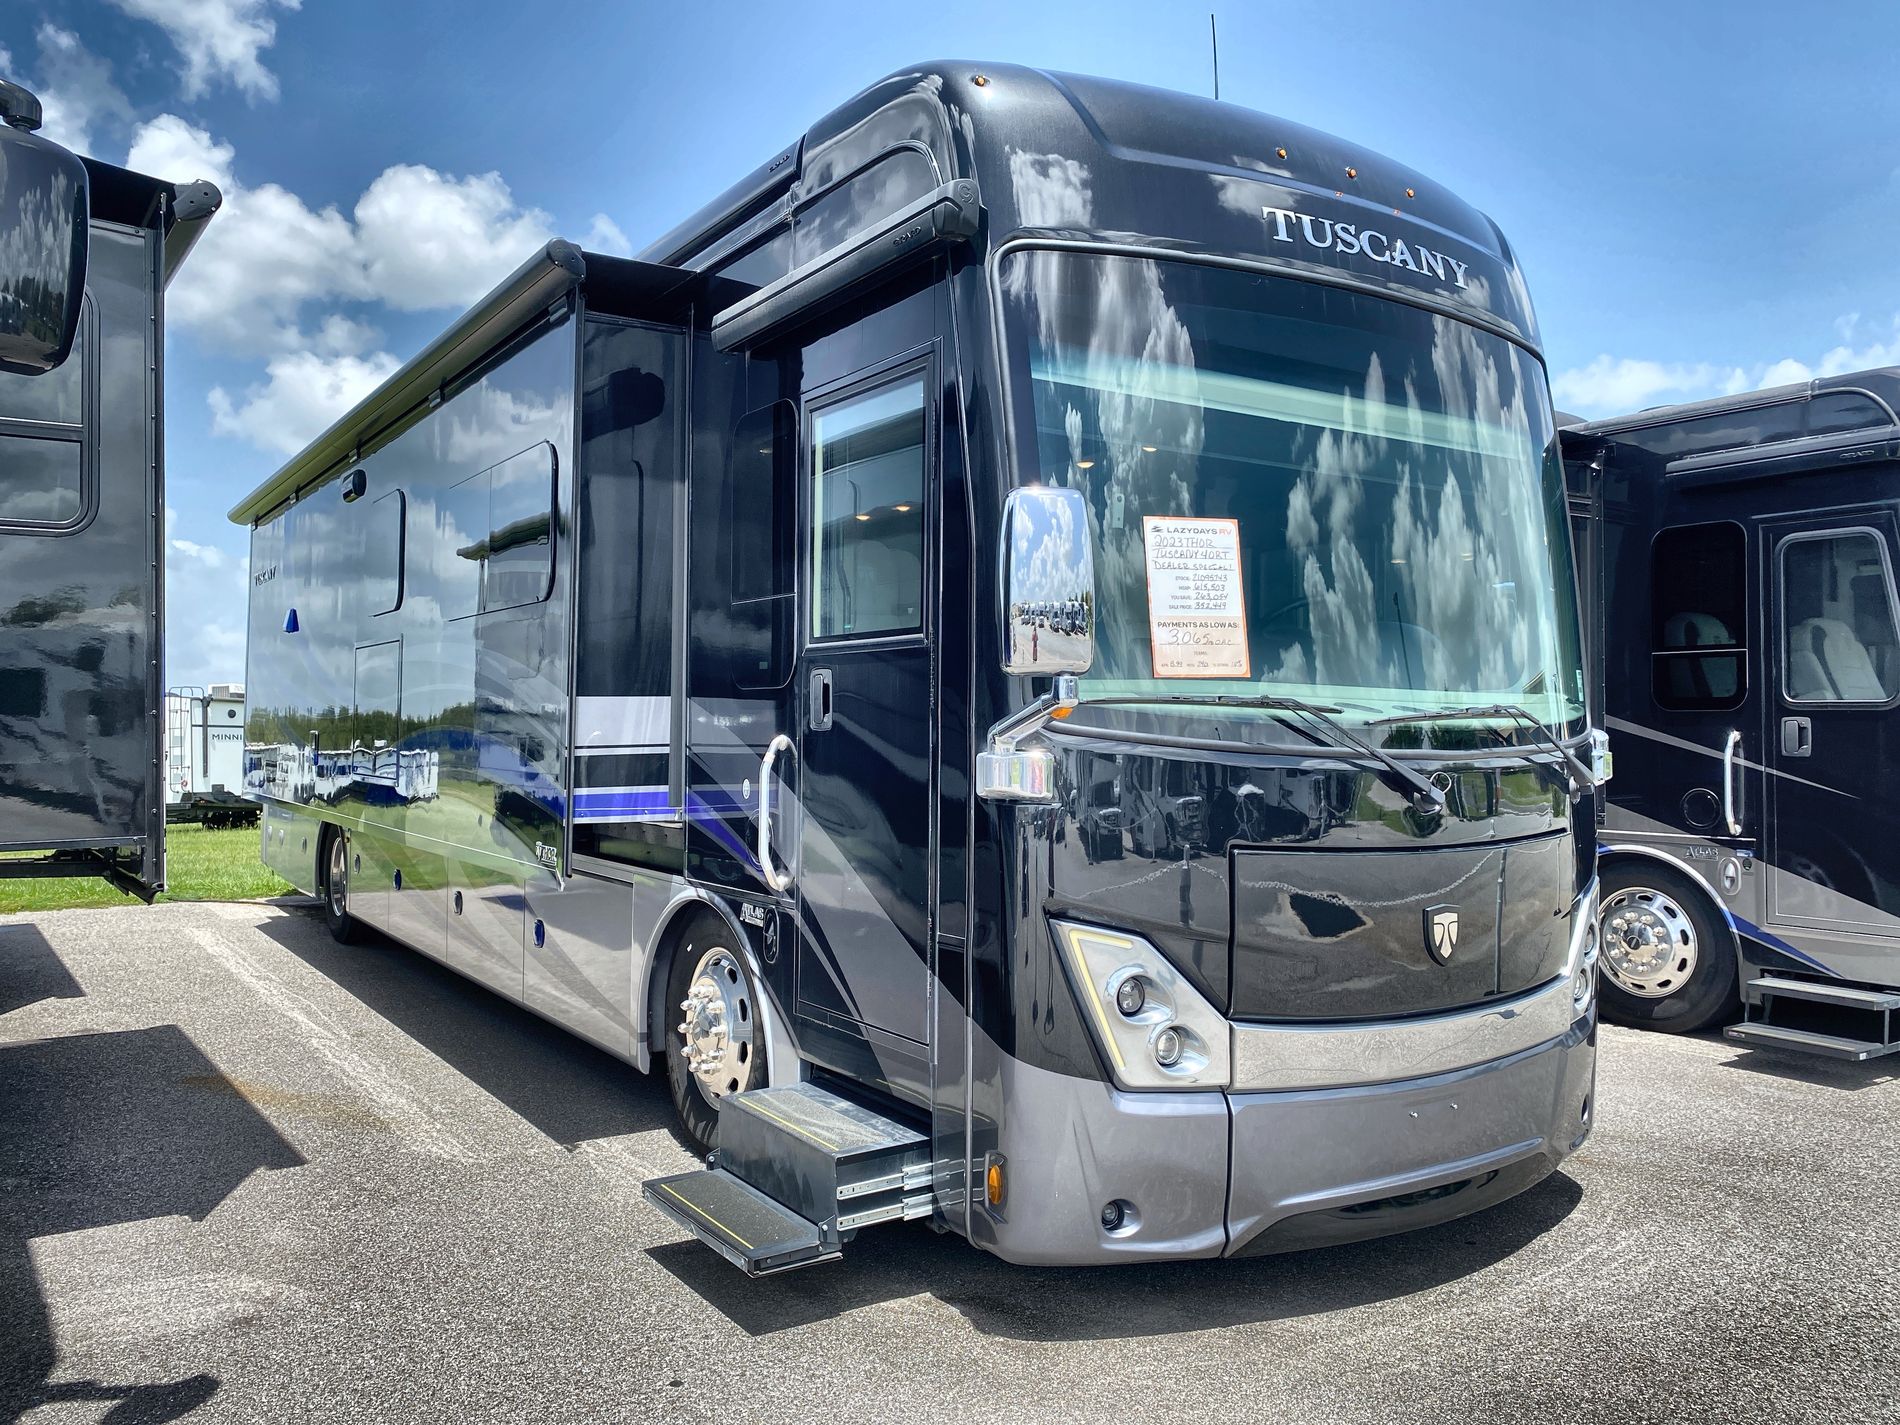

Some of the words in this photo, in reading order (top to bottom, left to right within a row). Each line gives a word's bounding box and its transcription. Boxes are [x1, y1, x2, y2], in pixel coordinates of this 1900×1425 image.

[1261, 206, 1469, 290] TUSCANY
[1166, 527, 1218, 535] LAZYDAYS
[1219, 528, 1232, 536] RV
[1154, 534, 1184, 548] 2023
[1184, 537, 1216, 548] THOR
[1152, 548, 1200, 559] TUSCANY
[1152, 560, 1190, 570] DEALER
[1198, 621, 1209, 629] AS
